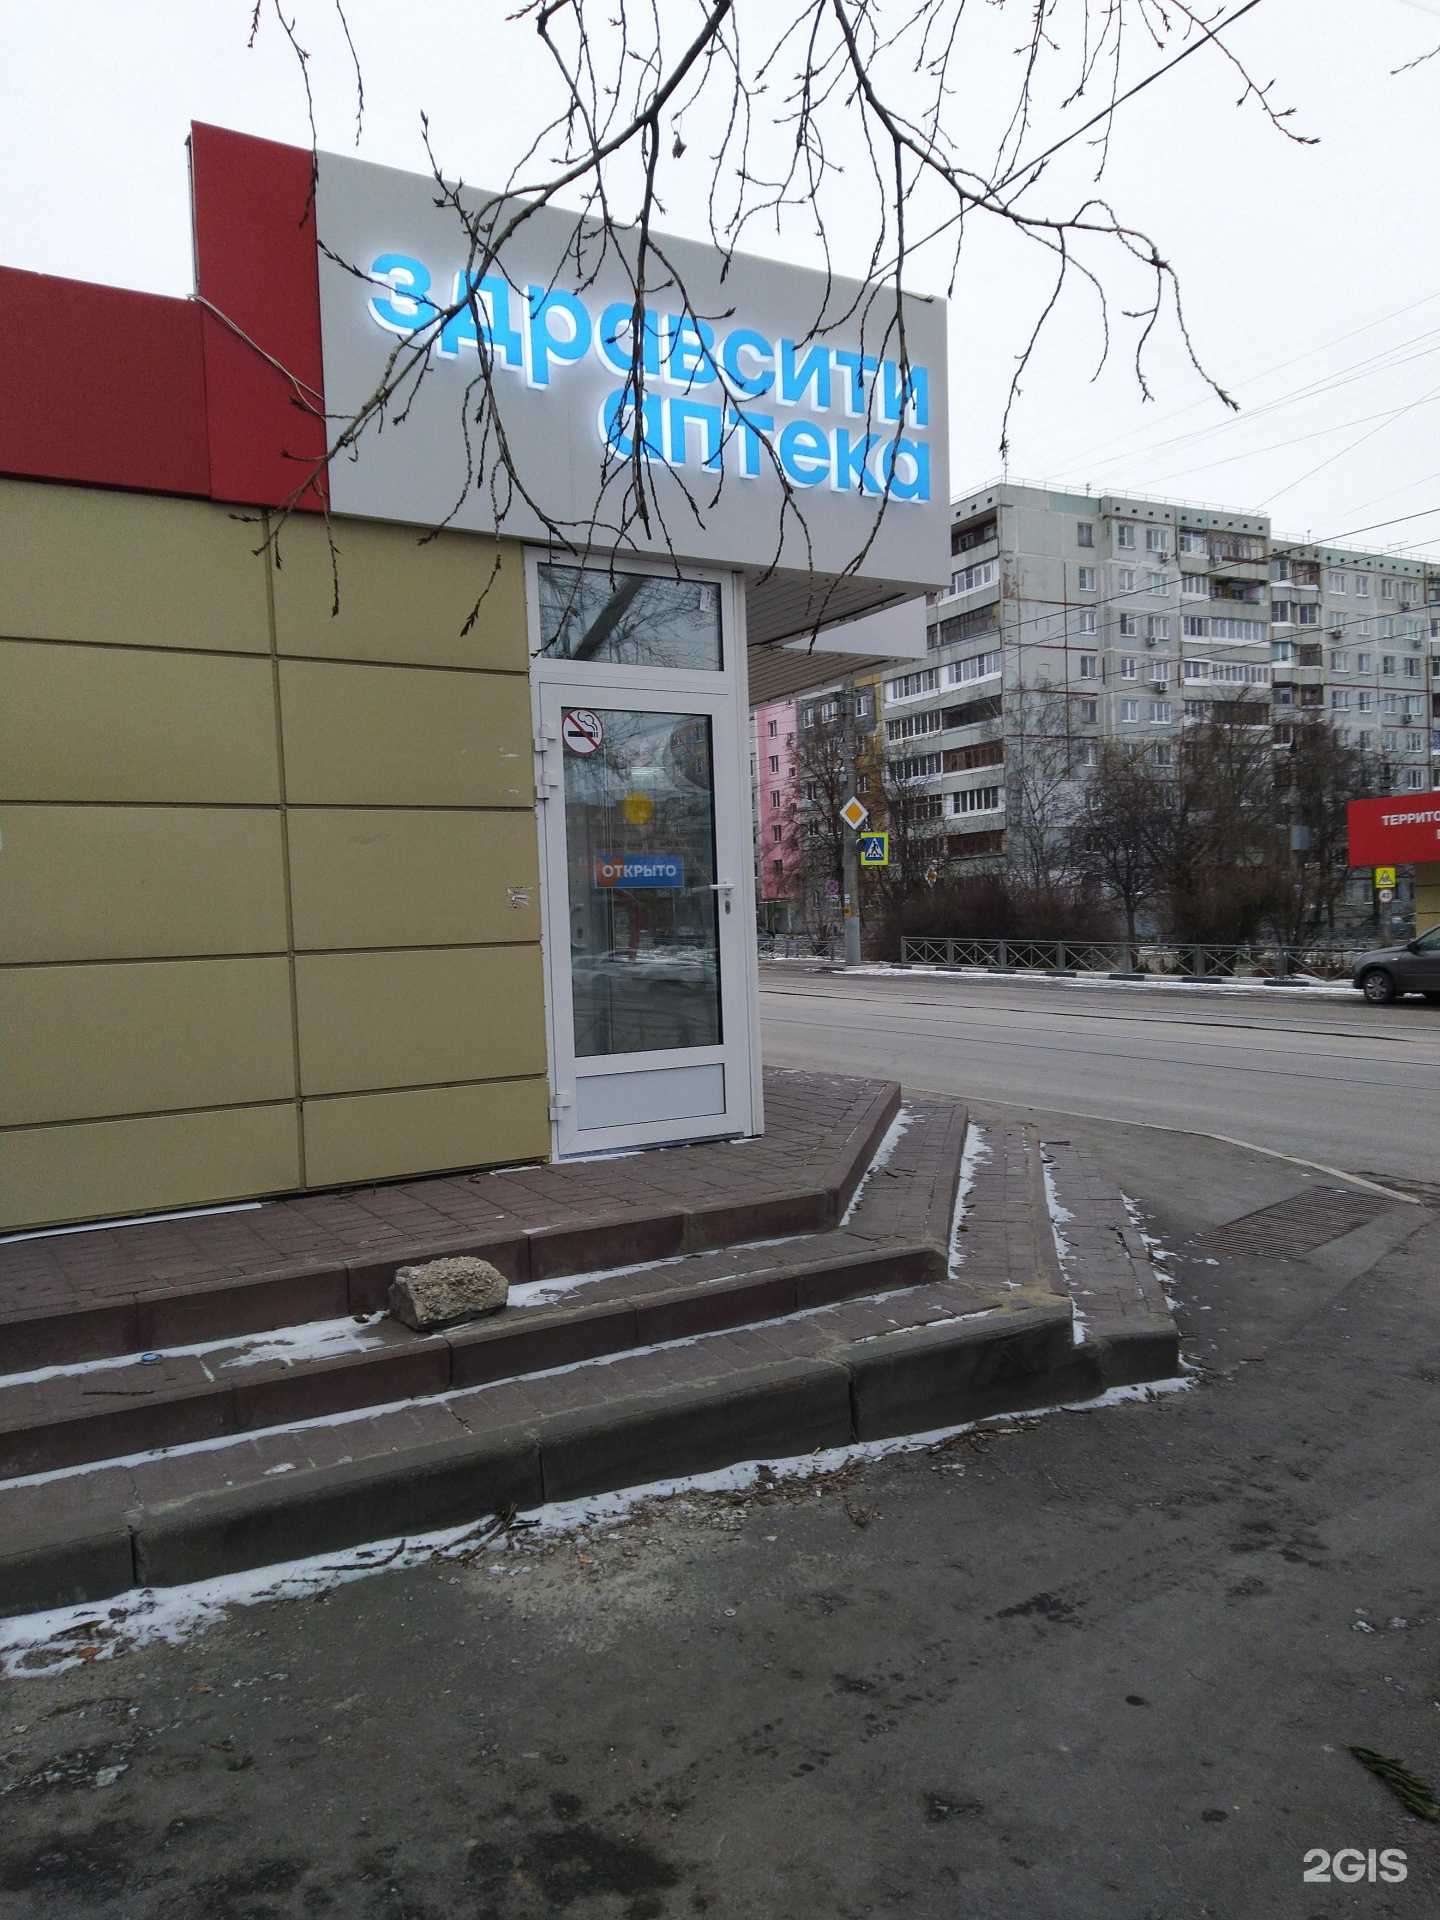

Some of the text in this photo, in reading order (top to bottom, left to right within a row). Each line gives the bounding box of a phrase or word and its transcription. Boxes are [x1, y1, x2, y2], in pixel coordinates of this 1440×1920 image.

[368, 253, 929, 428] здравсити
[599, 388, 931, 503] аптека
[602, 864, 677, 878] ОТКРЫТО
